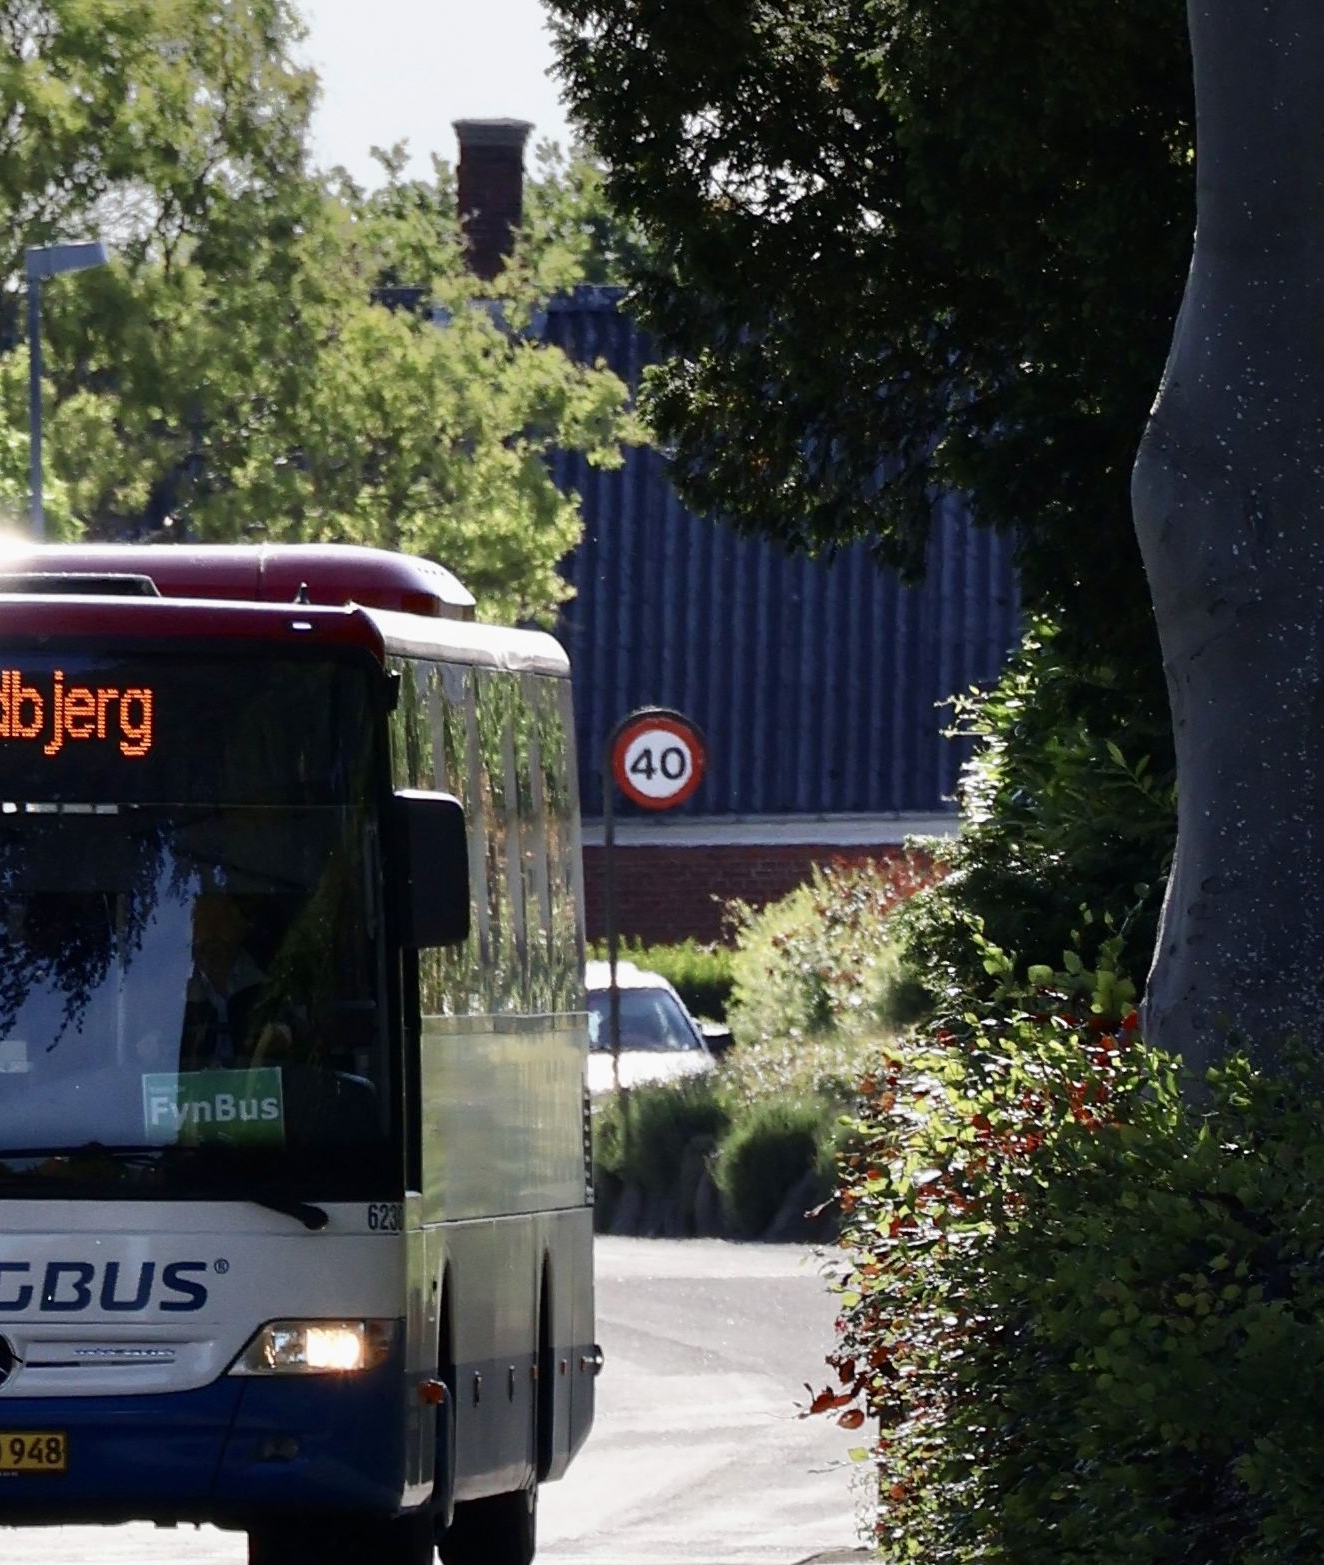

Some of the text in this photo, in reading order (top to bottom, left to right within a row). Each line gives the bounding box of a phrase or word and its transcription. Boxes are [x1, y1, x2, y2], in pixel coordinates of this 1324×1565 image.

[630, 747, 685, 780] 40
[151, 1093, 280, 1131] FynBus
[9, 1437, 62, 1465] 948
